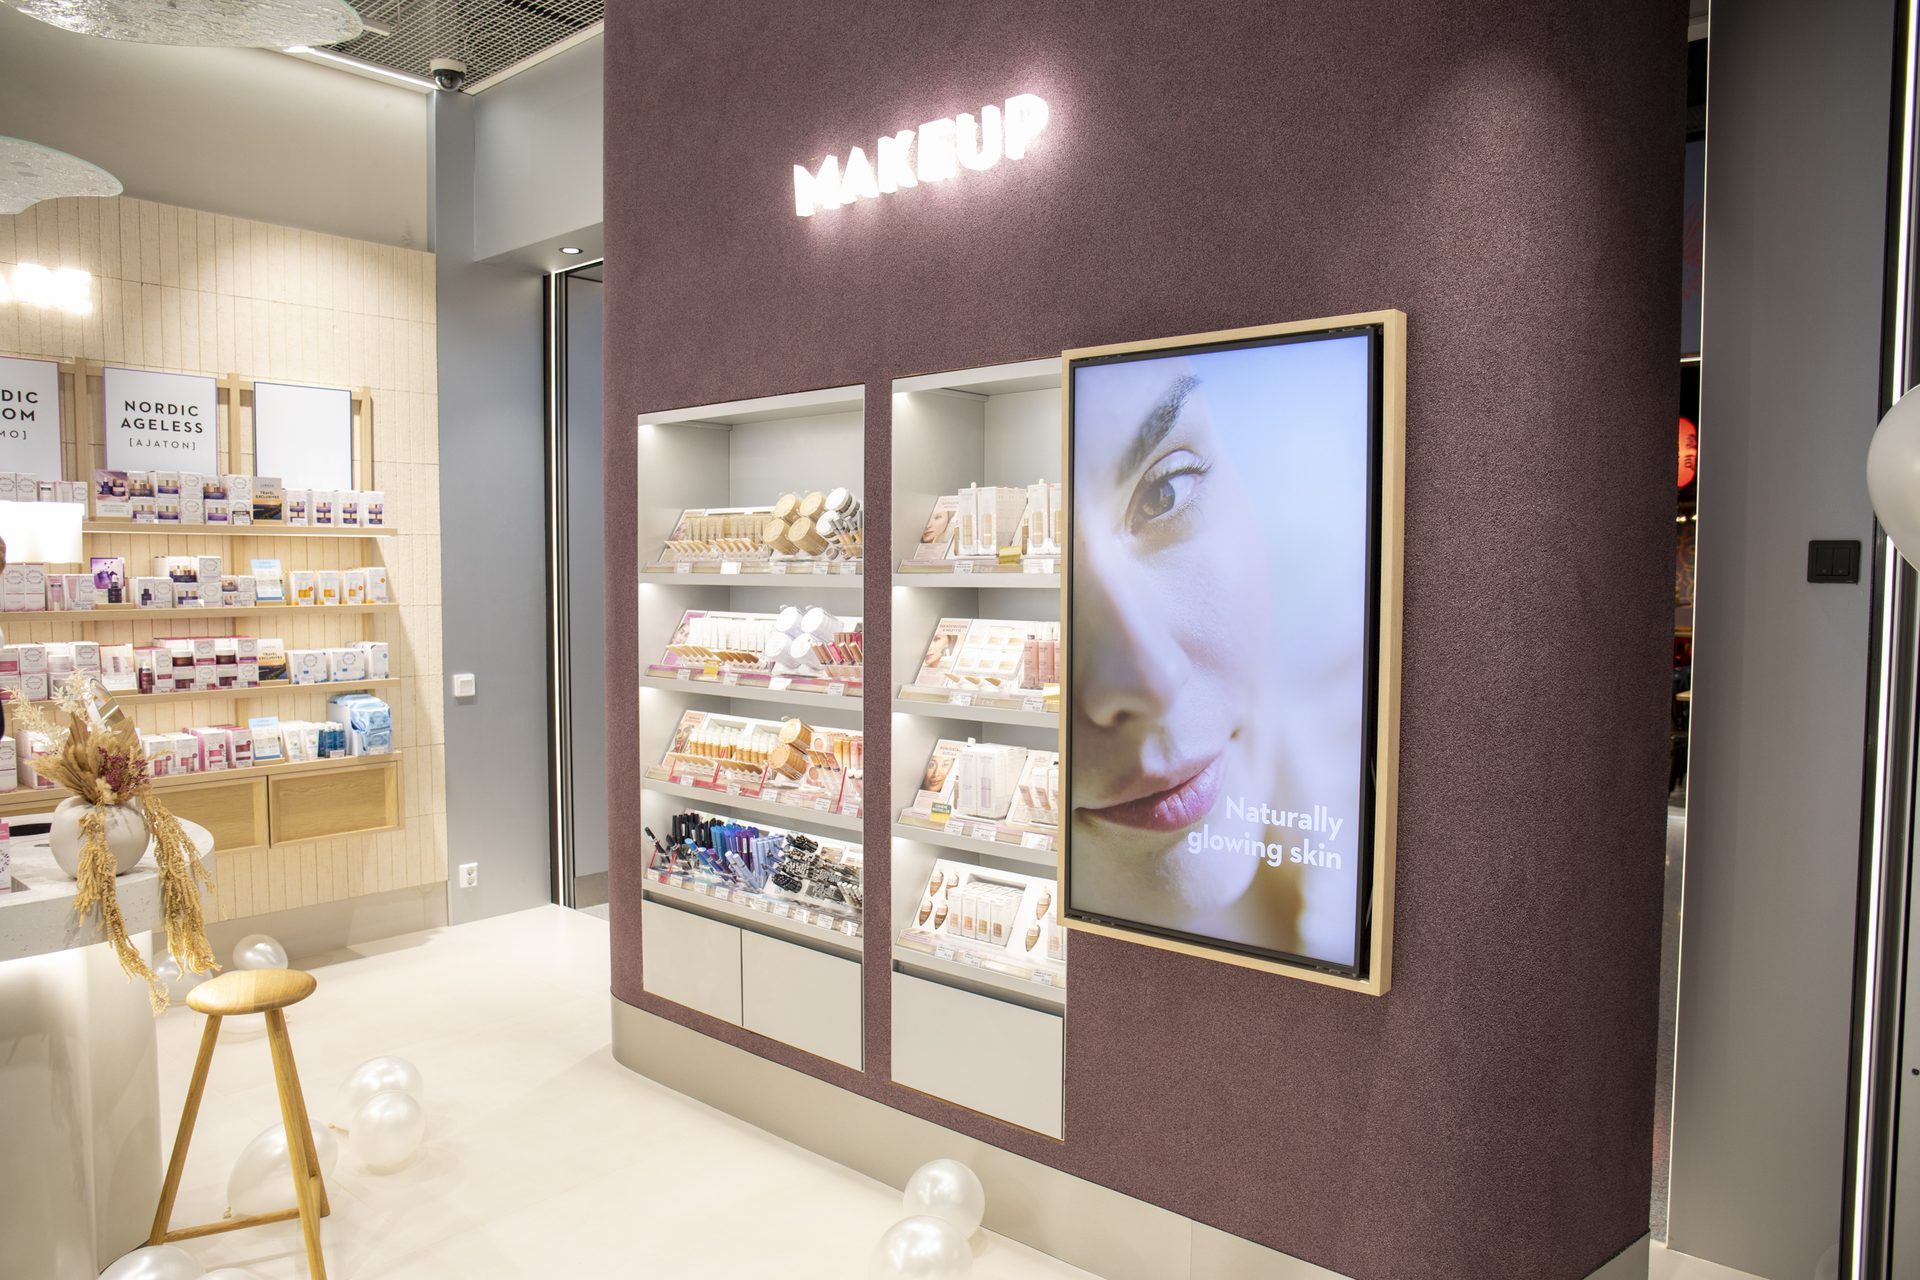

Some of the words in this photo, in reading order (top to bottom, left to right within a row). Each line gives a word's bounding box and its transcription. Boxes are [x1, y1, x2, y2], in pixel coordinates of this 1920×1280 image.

[793, 93, 1049, 217] MAKEUP
[124, 400, 199, 417] NORDIC
[121, 417, 203, 433] AGELESS
[129, 437, 196, 451] [AJATON]
[1226, 795, 1343, 840] Naturally
[1187, 823, 1283, 867] glowing
[1290, 838, 1342, 870] skin
